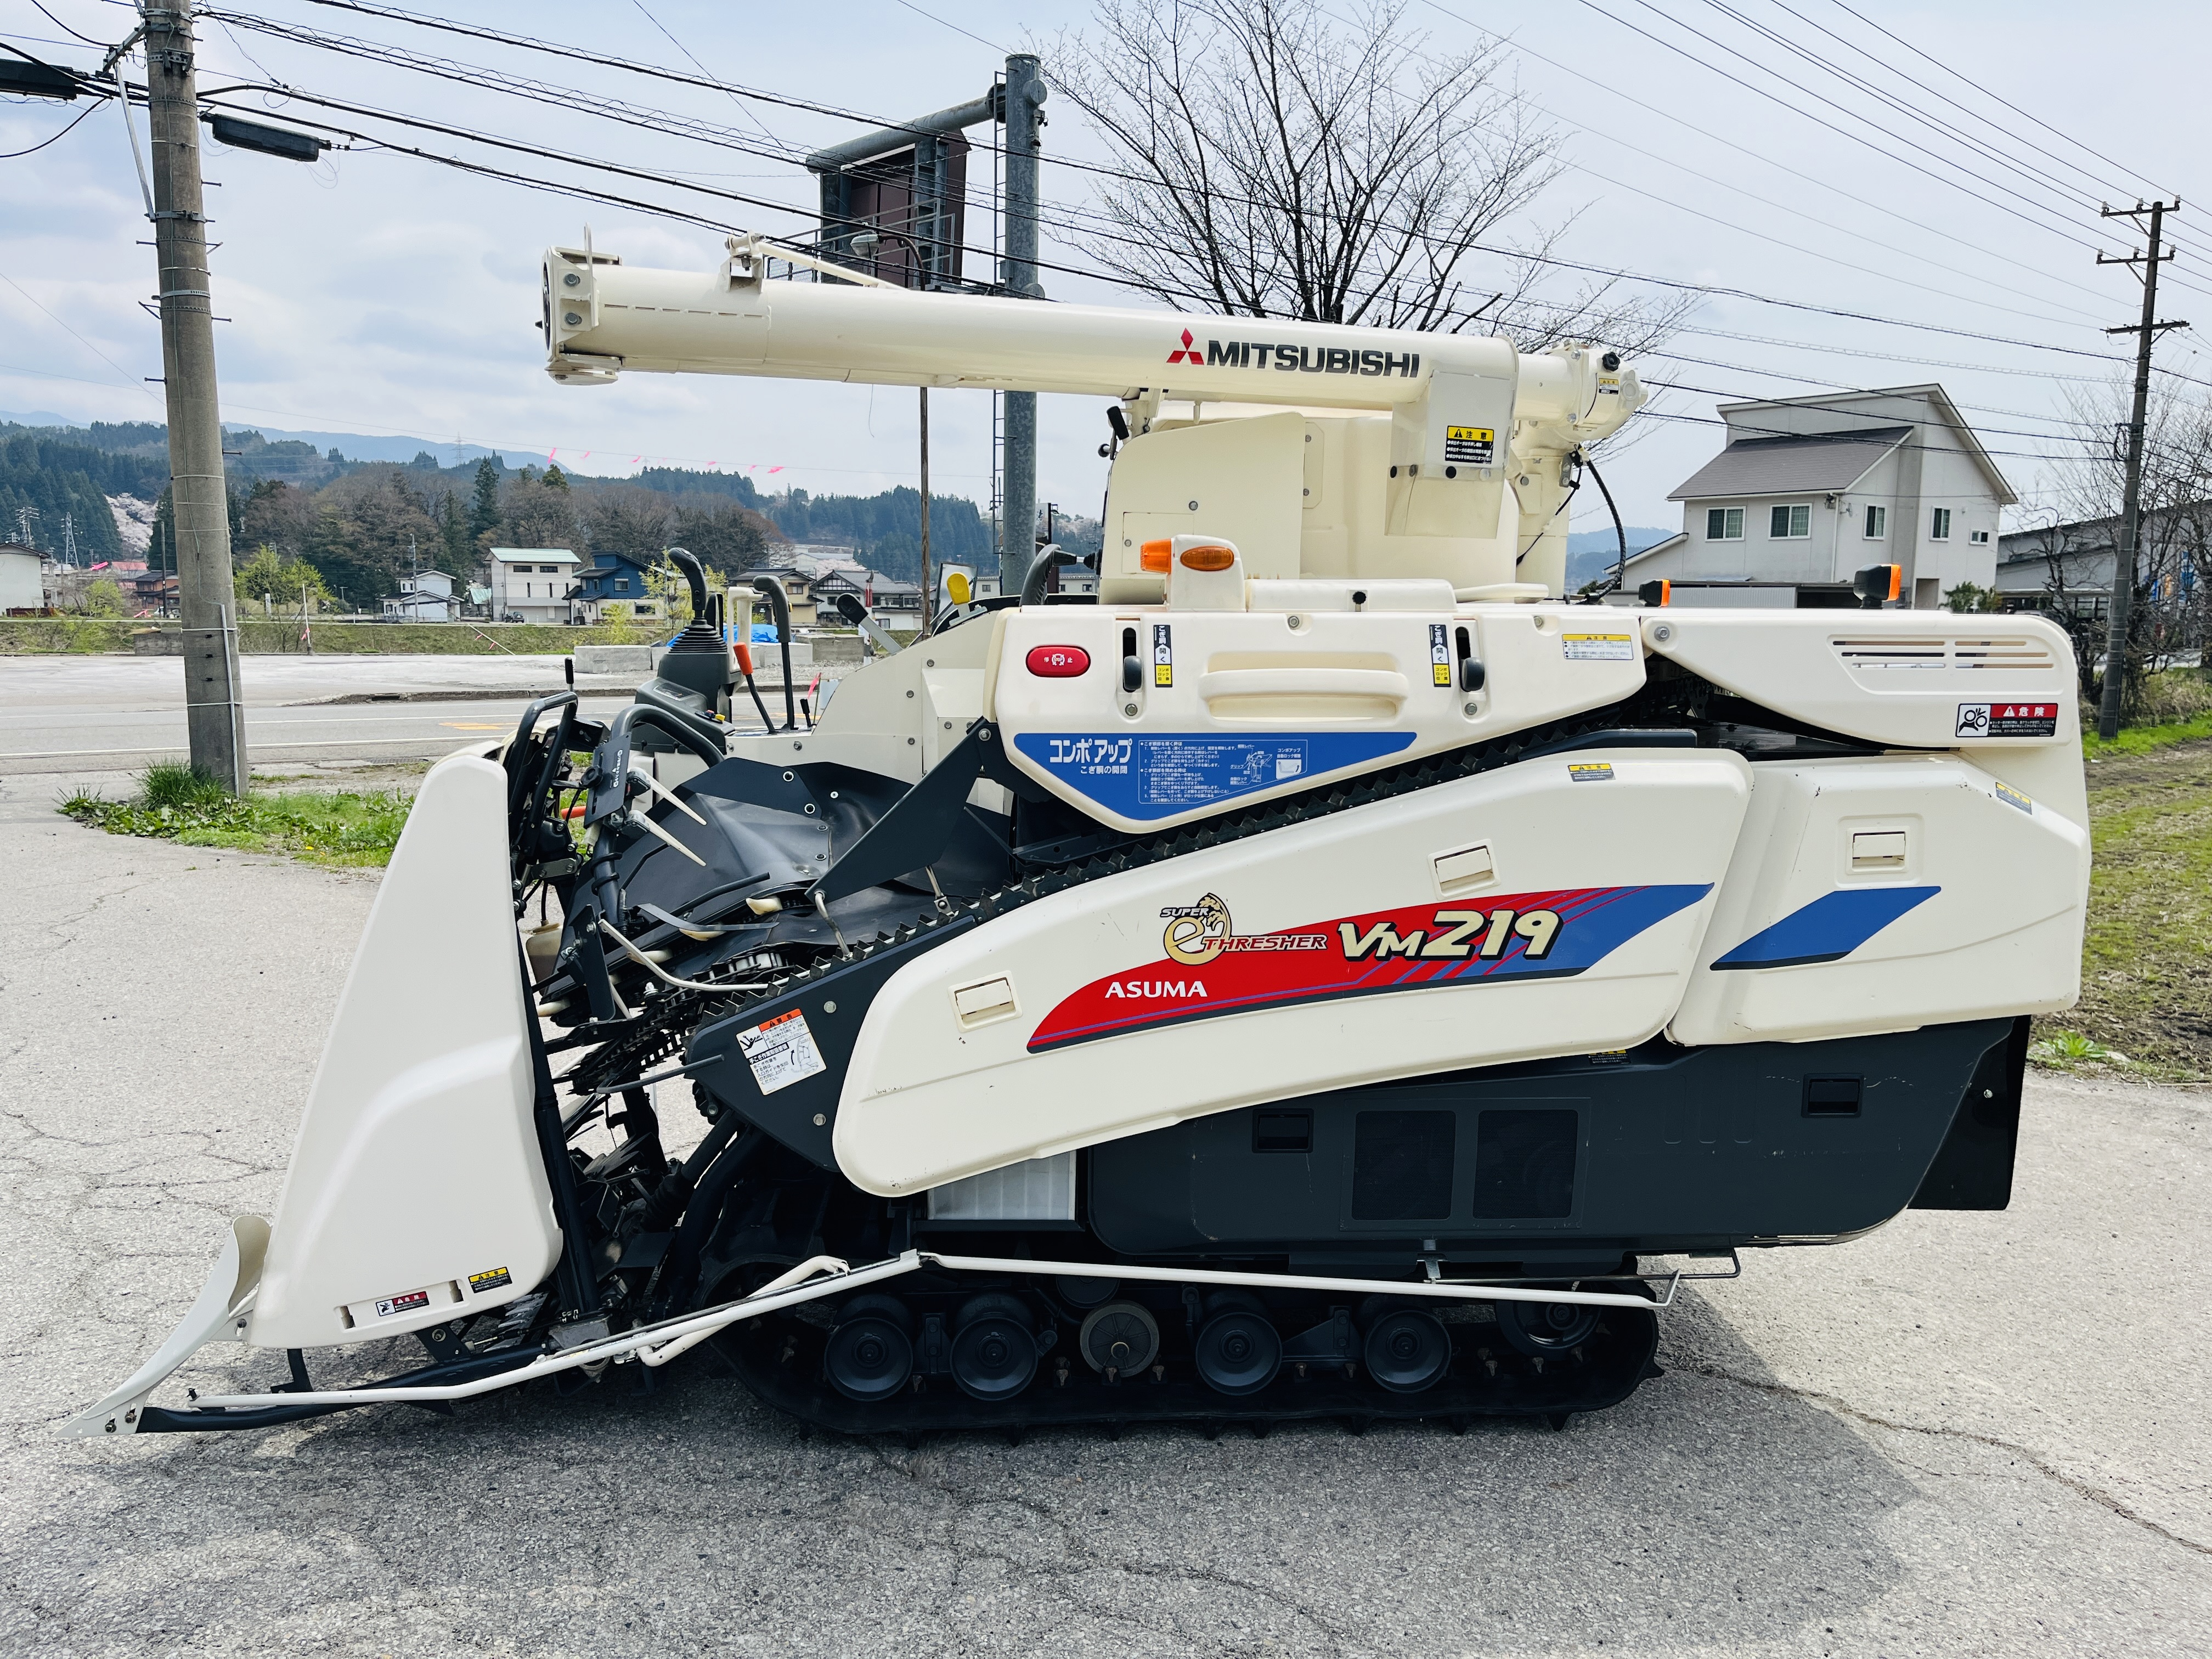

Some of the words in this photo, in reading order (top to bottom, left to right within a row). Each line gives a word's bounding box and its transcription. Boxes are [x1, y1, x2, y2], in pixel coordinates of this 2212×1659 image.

[1207, 340, 1420, 378] MITSUBISHI
[1049, 738, 1133, 764] コンポアップ
[1080, 765, 1128, 774] こぎ胴の開閉
[1161, 907, 1209, 917] SUPER
[1203, 935, 1328, 951] THRESHER
[1338, 909, 1562, 961] VM219
[1104, 981, 1208, 998] ASUMA
